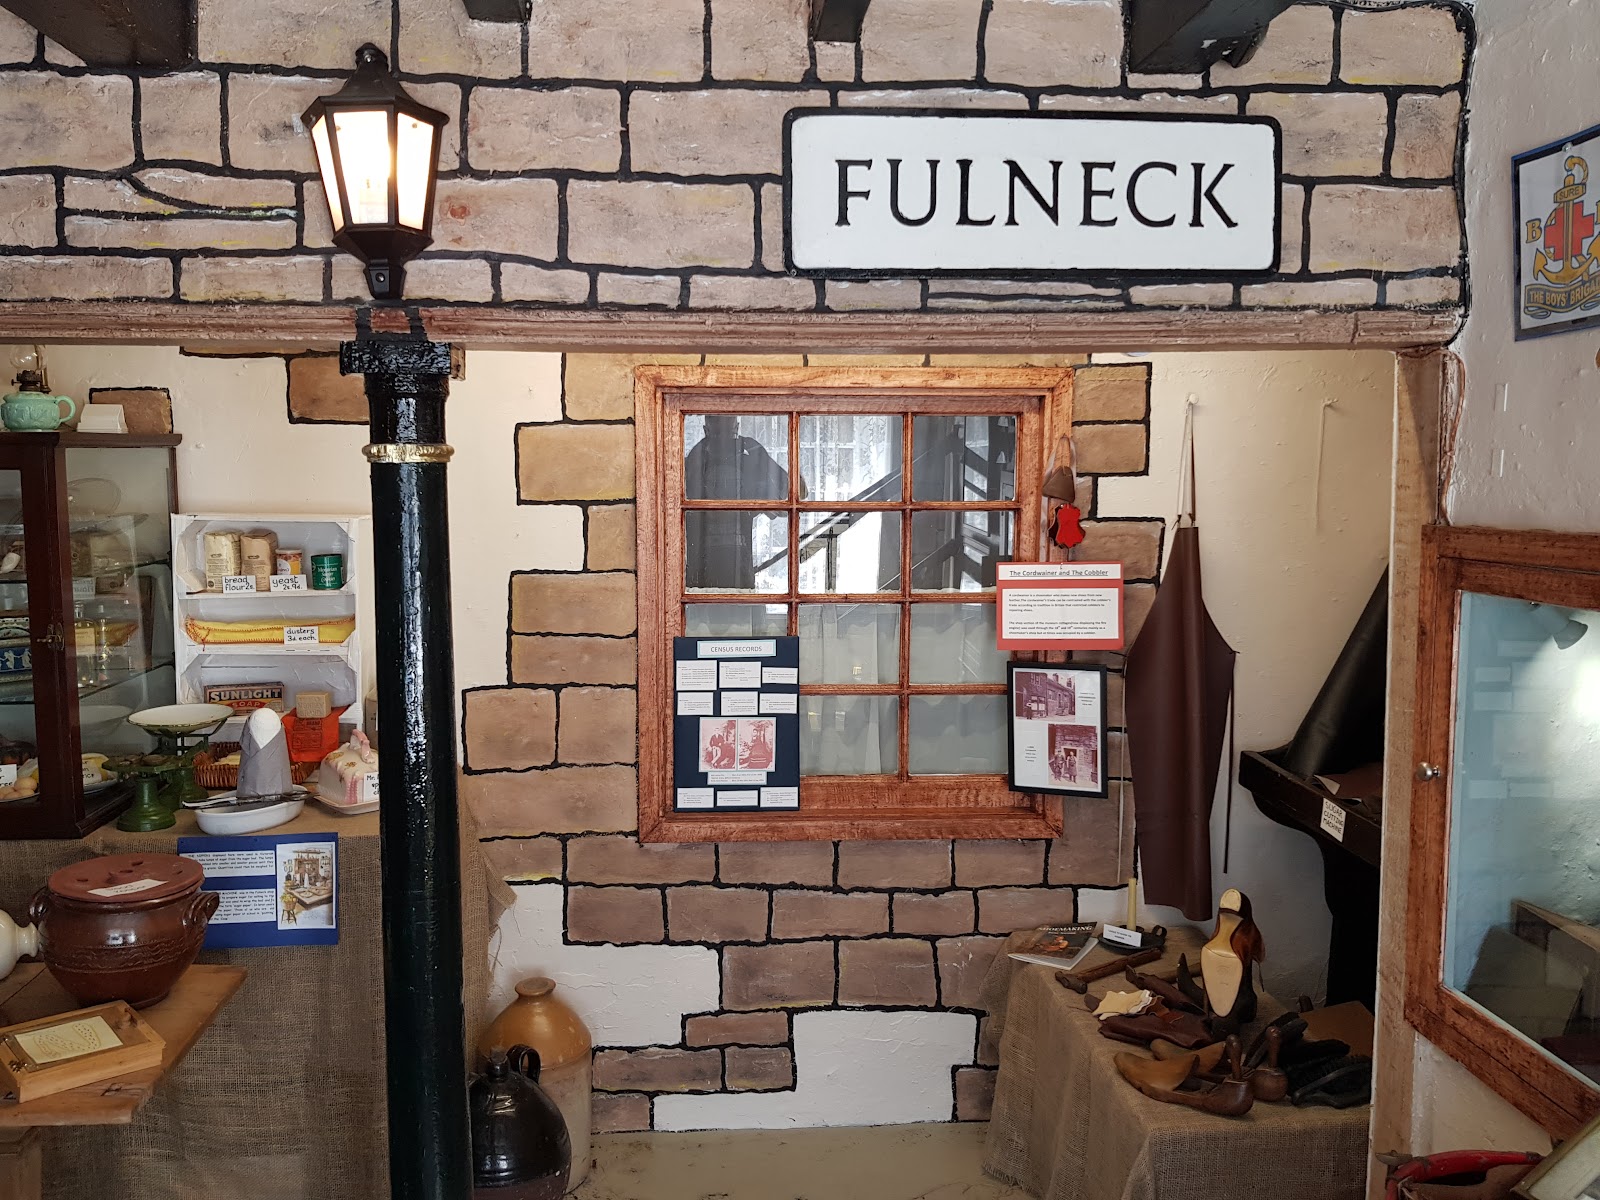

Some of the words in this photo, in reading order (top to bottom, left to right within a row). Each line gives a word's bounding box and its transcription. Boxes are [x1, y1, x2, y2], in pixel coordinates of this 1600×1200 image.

[835, 159, 1238, 228] FULNECK
[1558, 189, 1580, 201] SURE
[1526, 218, 1543, 243] B
[1530, 290, 1544, 304] THE
[1084, 569, 1108, 577] Cobbler
[225, 576, 248, 584] bread
[272, 576, 299, 588] yeast
[210, 689, 281, 702] SUNLIGHT
[1325, 801, 1343, 818] SUGAR
